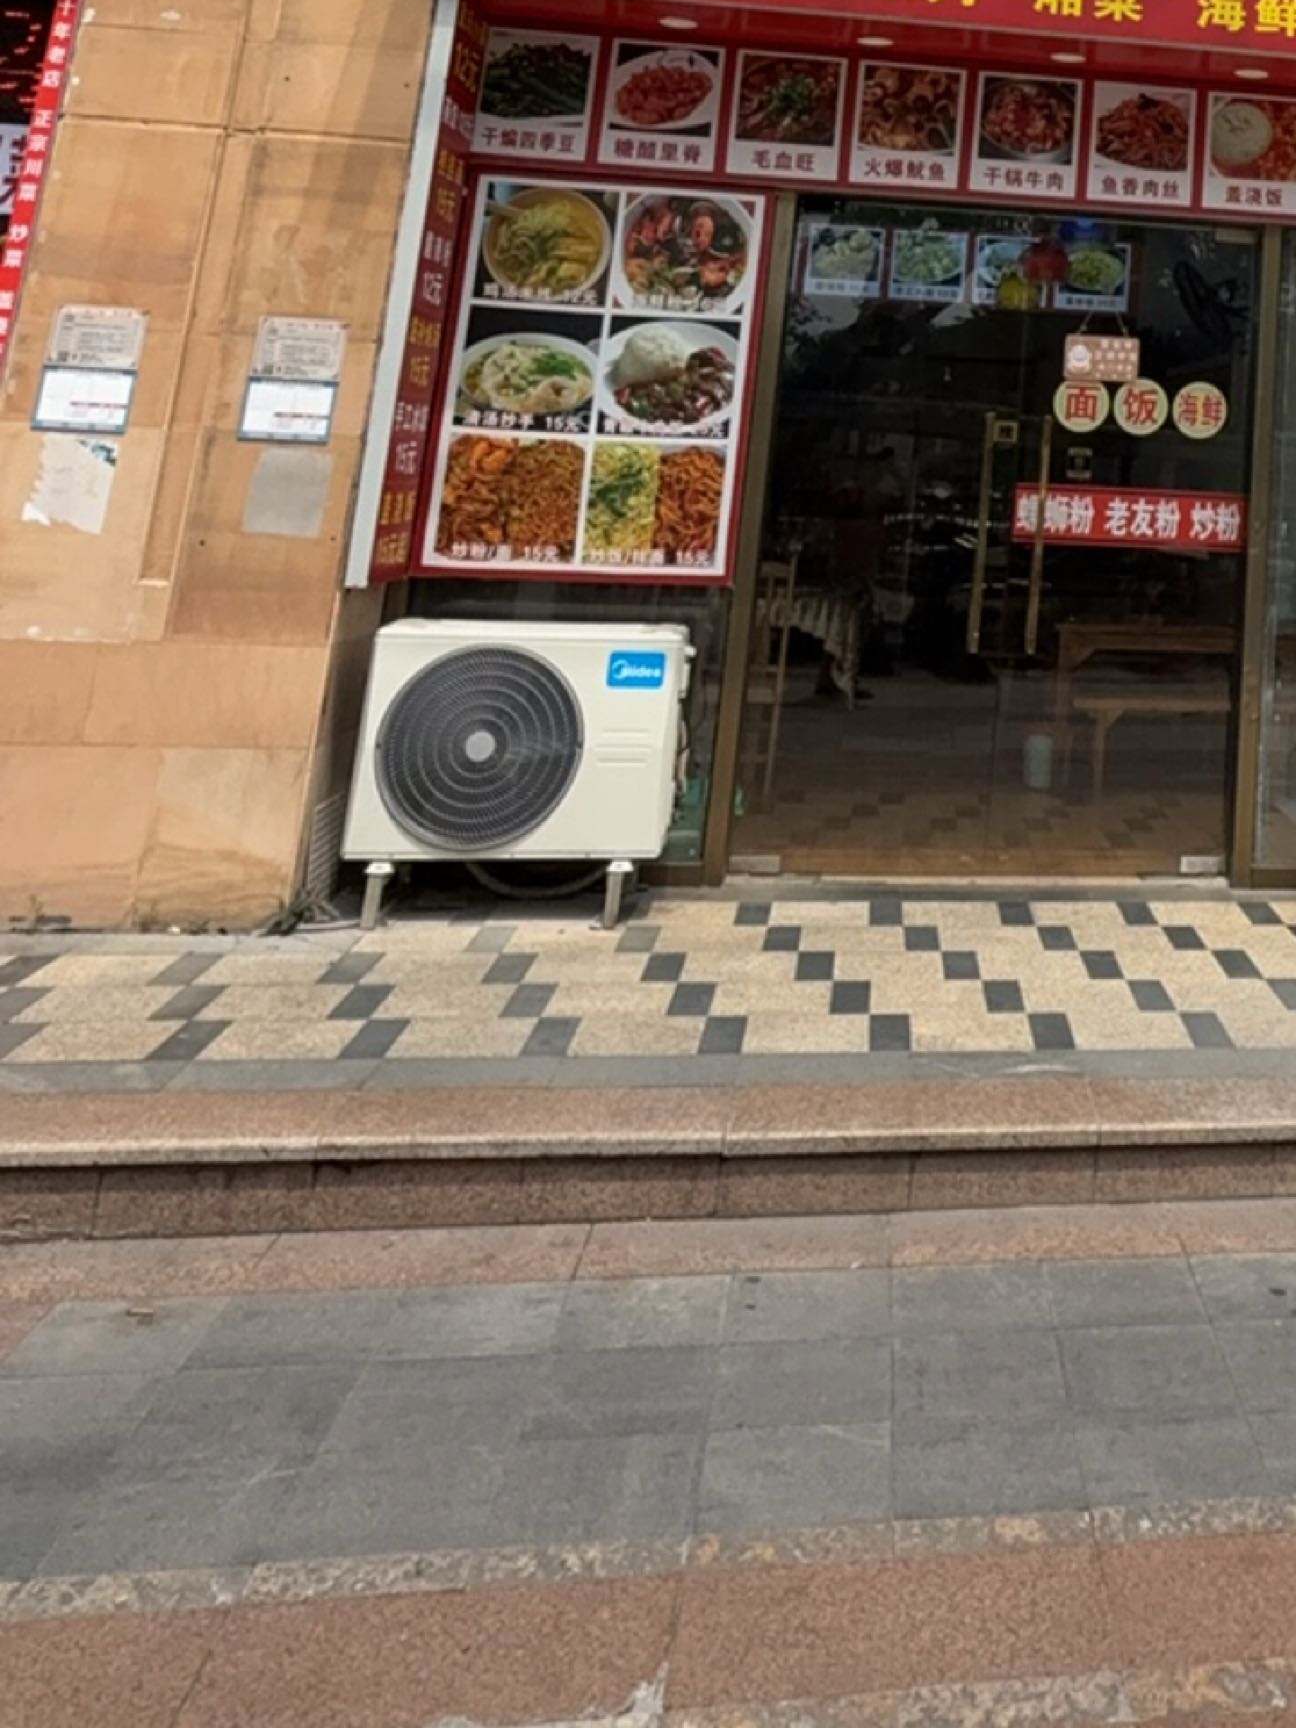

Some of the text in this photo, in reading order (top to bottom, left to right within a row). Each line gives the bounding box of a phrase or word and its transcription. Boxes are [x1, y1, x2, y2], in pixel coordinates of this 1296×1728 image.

[751, 150, 816, 173] 毛血旺
[982, 167, 1066, 192] 干锅牛肉
[1100, 175, 1181, 200] 鱼香肉丝
[1065, 385, 1223, 427] 面 饭 海鲜
[1103, 496, 1181, 539] 老友粉
[1189, 502, 1241, 541] 炒粉
